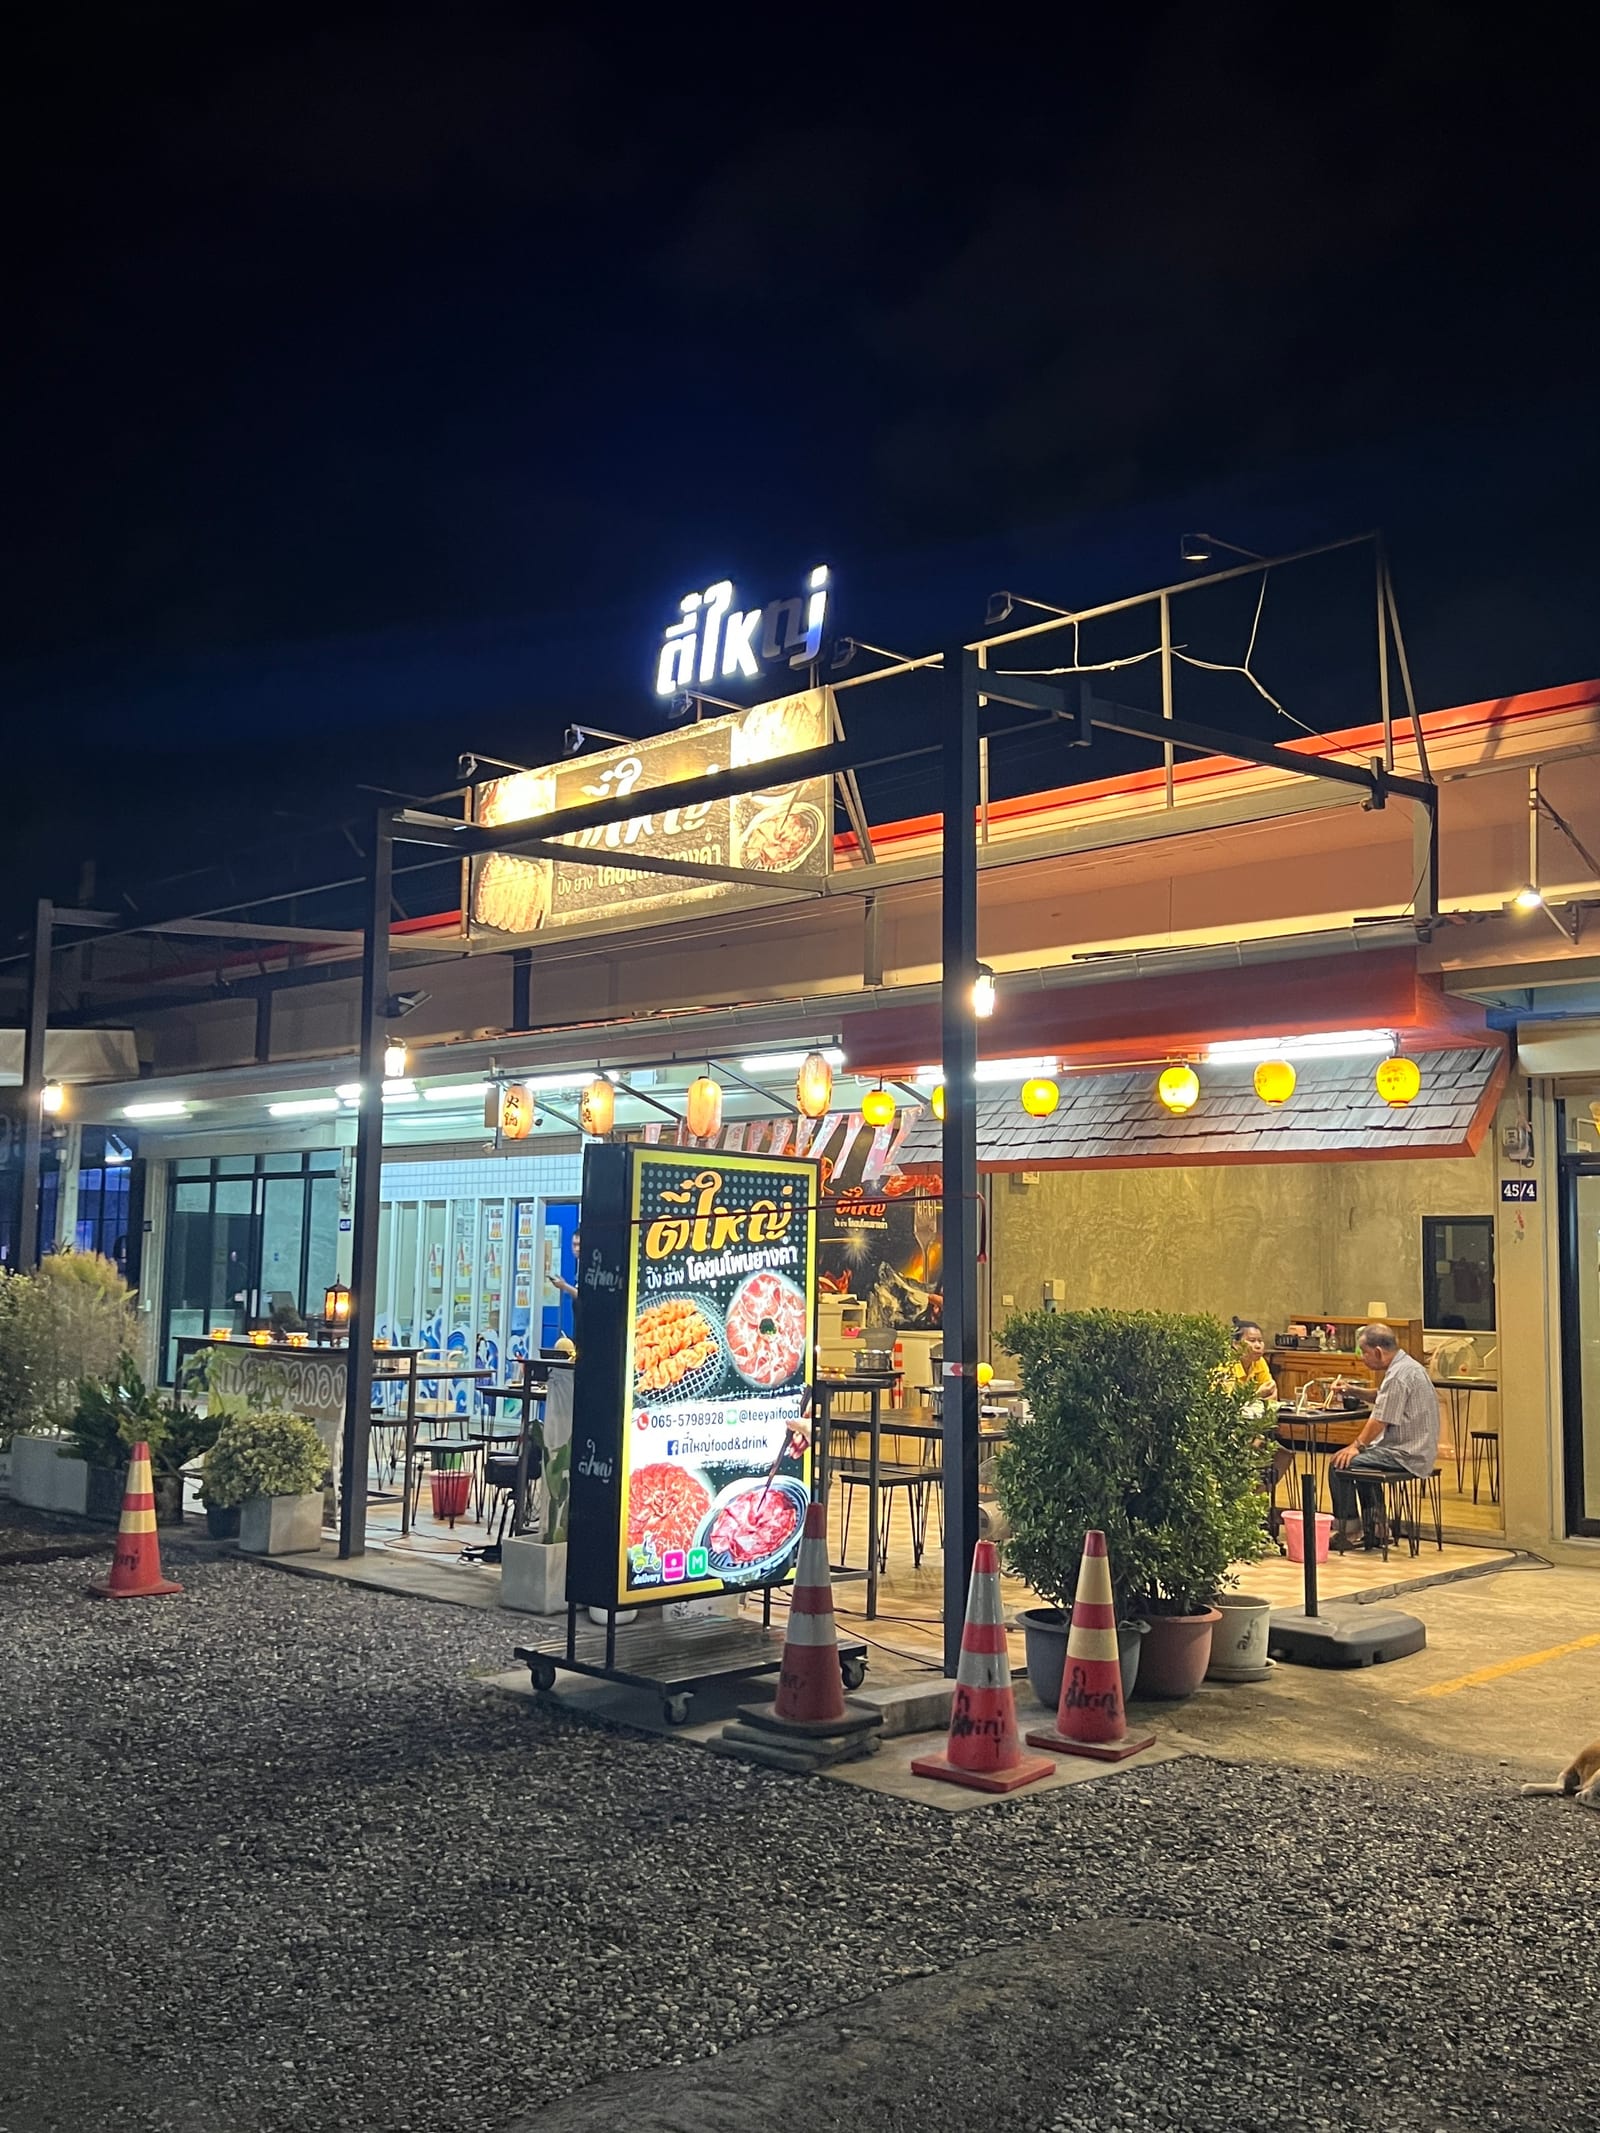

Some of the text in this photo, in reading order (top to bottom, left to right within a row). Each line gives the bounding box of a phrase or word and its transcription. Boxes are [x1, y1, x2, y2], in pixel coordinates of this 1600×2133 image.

[656, 563, 829, 696] ตี๋ใหญ่
[1503, 1183, 1535, 1197] 45/4
[646, 1170, 793, 1259] ตี๋ใหญ่
[645, 1265, 663, 1289] ปิ้ง
[665, 1264, 684, 1286] ย่าง
[651, 1407, 800, 1429] 065-5798928 @teeyaifood
